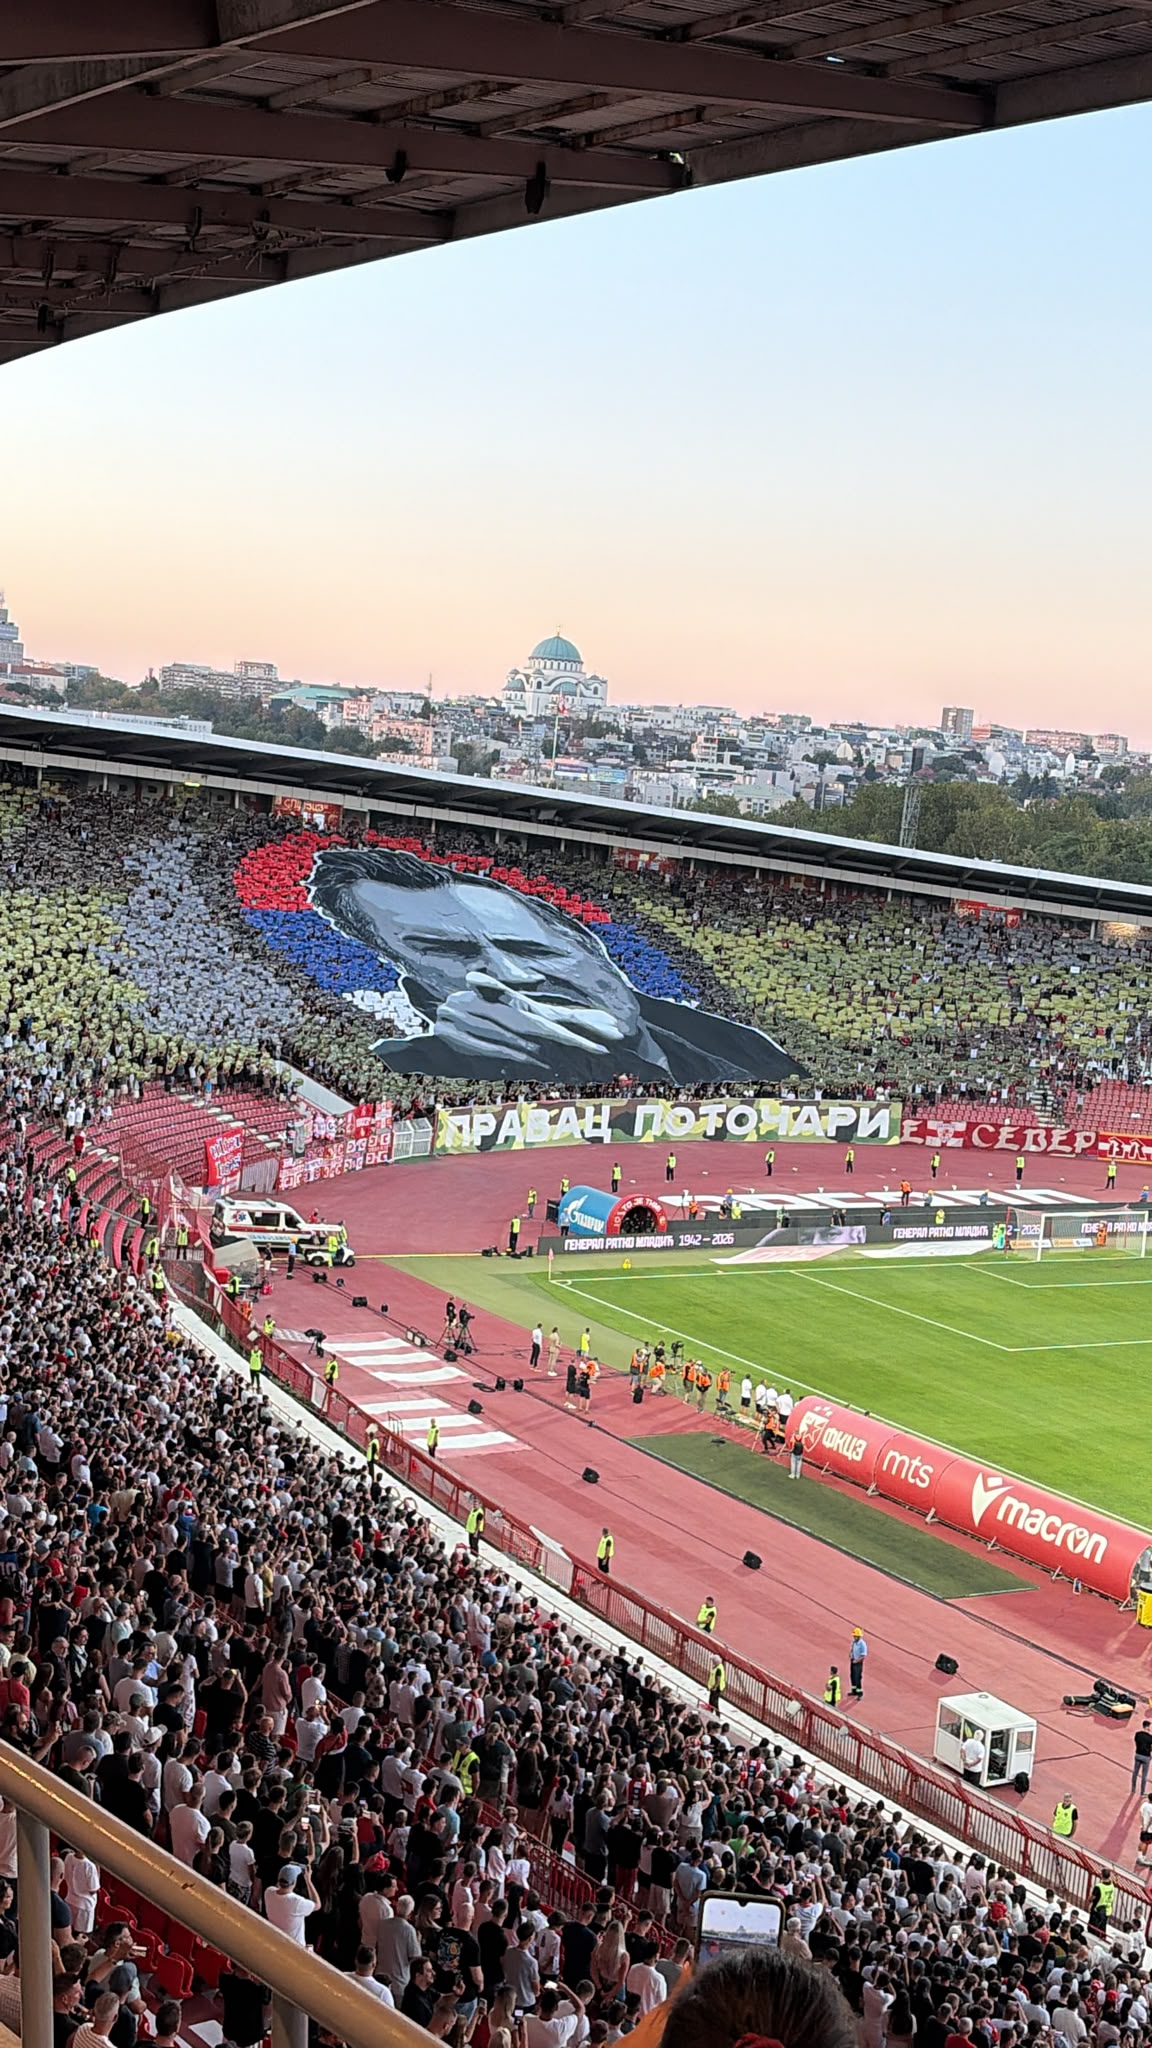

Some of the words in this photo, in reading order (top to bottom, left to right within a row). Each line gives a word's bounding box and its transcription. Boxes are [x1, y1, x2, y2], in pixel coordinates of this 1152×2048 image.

[444, 1105, 612, 1147] ПРАВАЦ
[633, 1104, 890, 1139] ПОТОЧАРИ
[971, 1124, 1097, 1154] СЕВЕР
[564, 1238, 604, 1251] ГЕНЕРАЛ
[605, 1237, 635, 1249] РАТКО
[635, 1235, 674, 1248] МЛАДИЋ
[678, 1234, 701, 1246] 1942
[711, 1232, 735, 1245] 2026
[892, 1226, 927, 1239] ГЕНЕРАЛ
[928, 1226, 954, 1238] РАТКО
[954, 1225, 989, 1238] МЛАДИЋ
[822, 1426, 868, 1462] ФКЦЗ
[881, 1449, 934, 1489] mts
[997, 1495, 1108, 1565] macron
